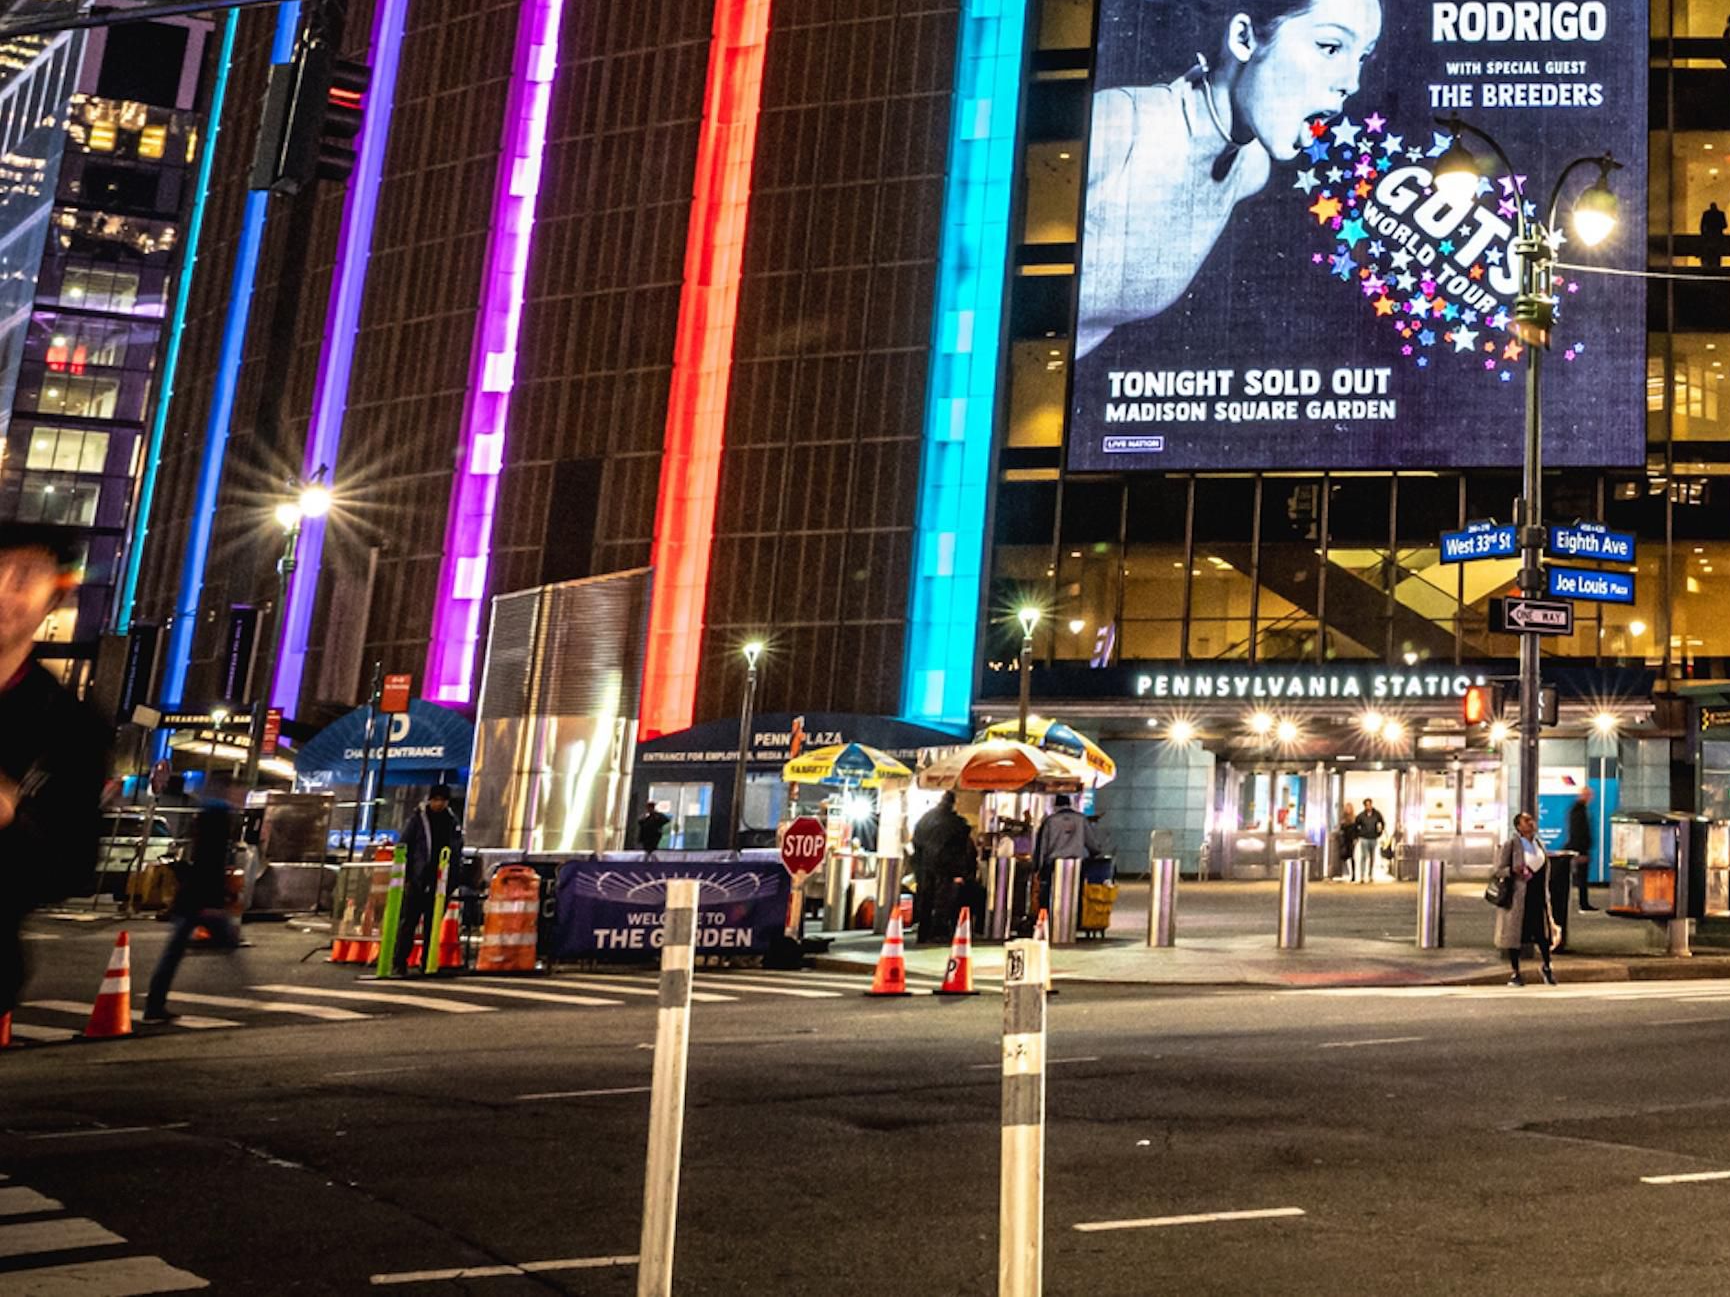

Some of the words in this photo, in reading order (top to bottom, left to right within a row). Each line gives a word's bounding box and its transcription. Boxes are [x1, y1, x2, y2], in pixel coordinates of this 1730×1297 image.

[1432, 1, 1607, 42] RODRIGO
[1446, 61, 1482, 75] WITH
[1486, 61, 1540, 75] SPECIAL
[1545, 61, 1587, 75] GUEST
[1428, 84, 1473, 108] THE
[1481, 83, 1604, 107] BREEDERS
[1363, 199, 1436, 267] WORLD
[1436, 262, 1498, 313] TOUR
[1108, 370, 1235, 398] TONIGHT
[1244, 369, 1322, 396] SOLD
[1331, 367, 1392, 395] OUT
[1105, 402, 1208, 423] MADISON
[1214, 401, 1299, 423] SQUARE
[1306, 400, 1397, 420] GARDEN
[1446, 537, 1475, 556] West
[1476, 533, 1498, 553] 33rd
[1499, 533, 1511, 550] St
[1556, 532, 1599, 554] Eighth
[1602, 537, 1628, 555] Ave
[1556, 574, 1576, 592] Joe
[1578, 575, 1608, 594] Louis
[1516, 610, 1533, 621] ONE
[1542, 612, 1562, 623] WAY
[1137, 675, 1360, 697] PENNSYLVANIA
[753, 731, 791, 747] PENN
[344, 747, 375, 760] CHAE
[388, 745, 444, 759] ENTRANCE
[642, 751, 686, 762] ENTRANCE
[687, 751, 703, 762] FOR
[783, 834, 825, 858] STOP
[706, 912, 726, 925] TO
[593, 928, 645, 949] THE
